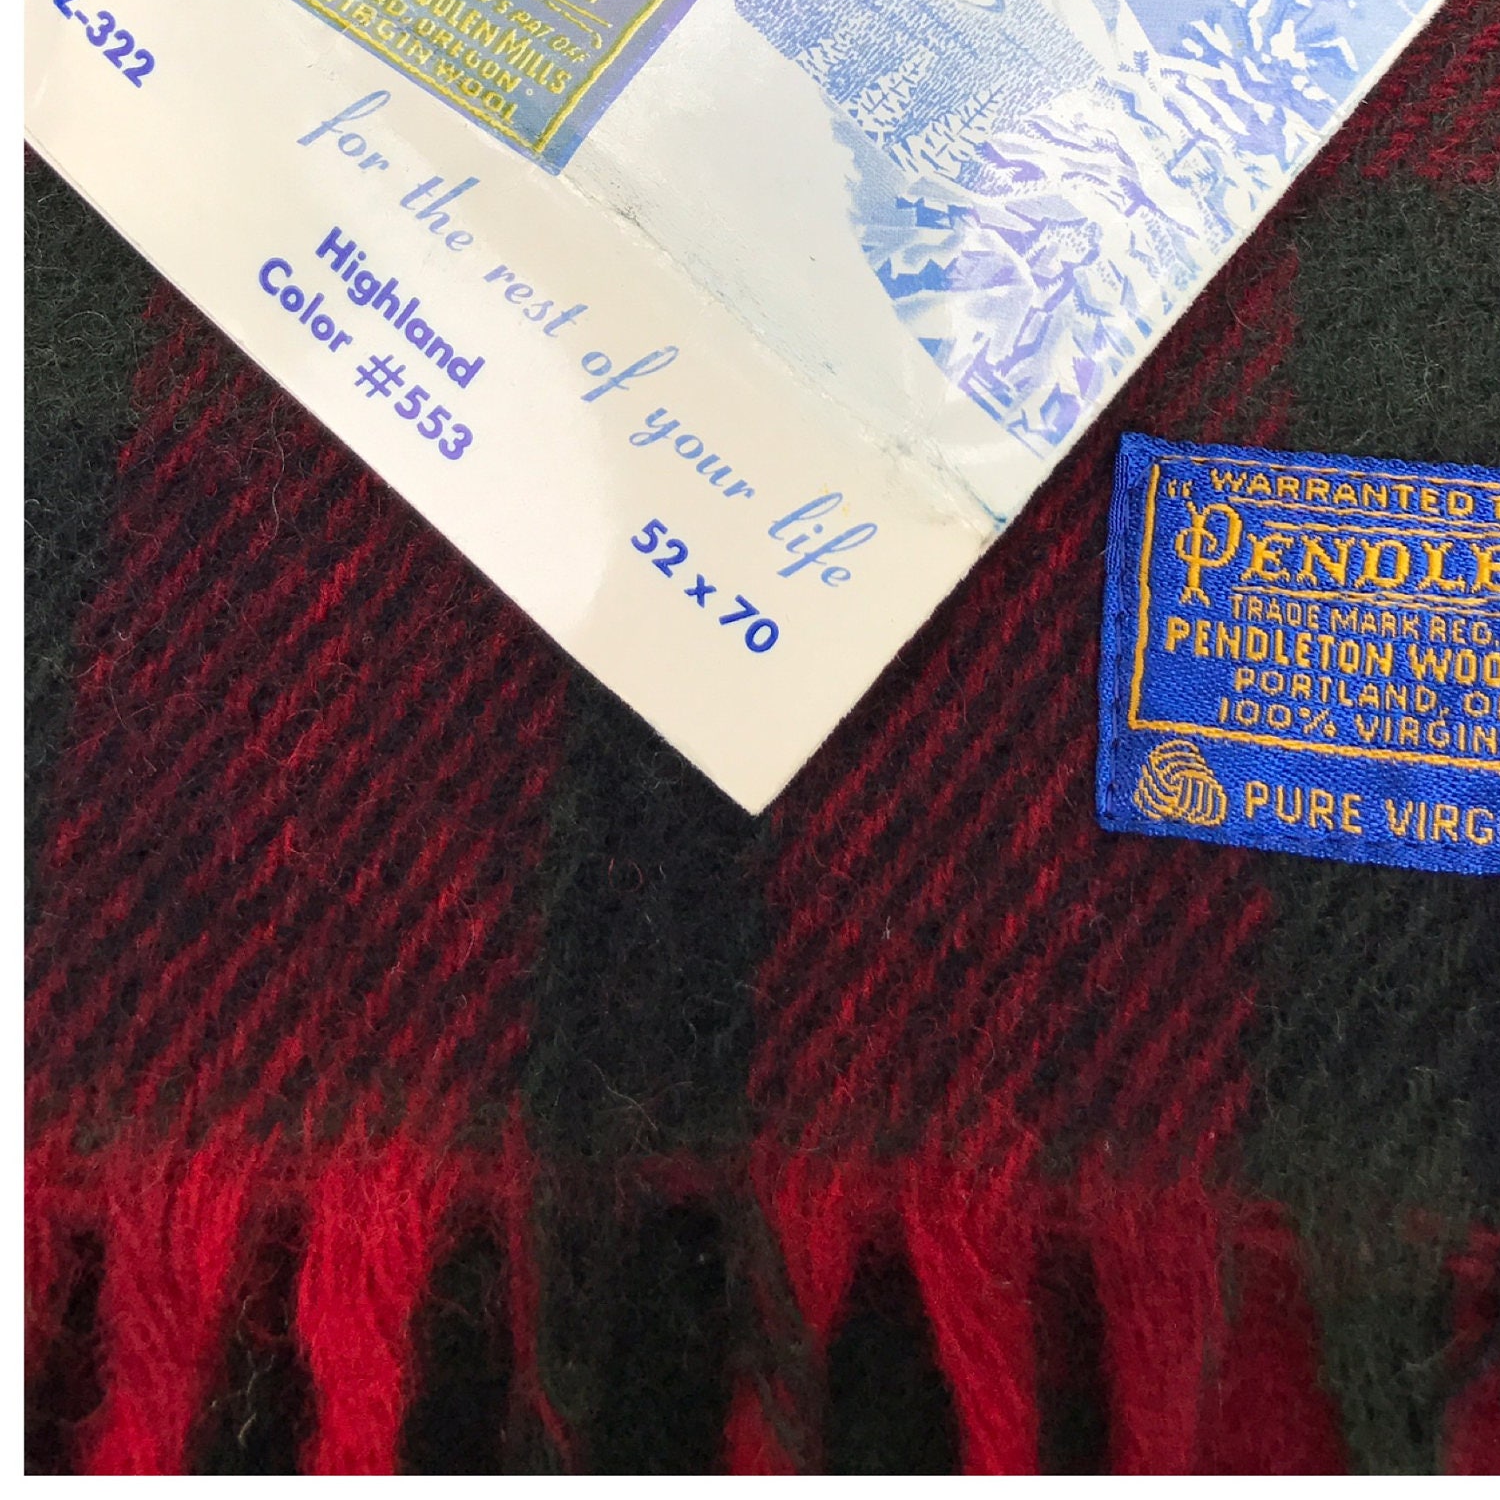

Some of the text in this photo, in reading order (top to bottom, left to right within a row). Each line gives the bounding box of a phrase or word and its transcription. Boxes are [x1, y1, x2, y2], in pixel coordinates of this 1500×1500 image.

[414, 18, 523, 92] OREGON
[494, 28, 572, 95] MILLS
[434, 58, 518, 125] WOOL
[296, 90, 878, 587] for the rest of your life
[315, 226, 486, 389] Highland
[258, 257, 474, 461] Color #553
[1210, 468, 1474, 517] WARRANTED
[630, 518, 779, 653] 52 x 70
[1230, 594, 1320, 630] TRADE
[1330, 607, 1420, 640] MARK
[1164, 616, 1393, 677] PENDLETON
[1218, 696, 1337, 738] 100%
[1355, 715, 1498, 757] VIRGIN
[1234, 667, 1450, 720] PORTLAND,
[1244, 779, 1362, 834] PURE
